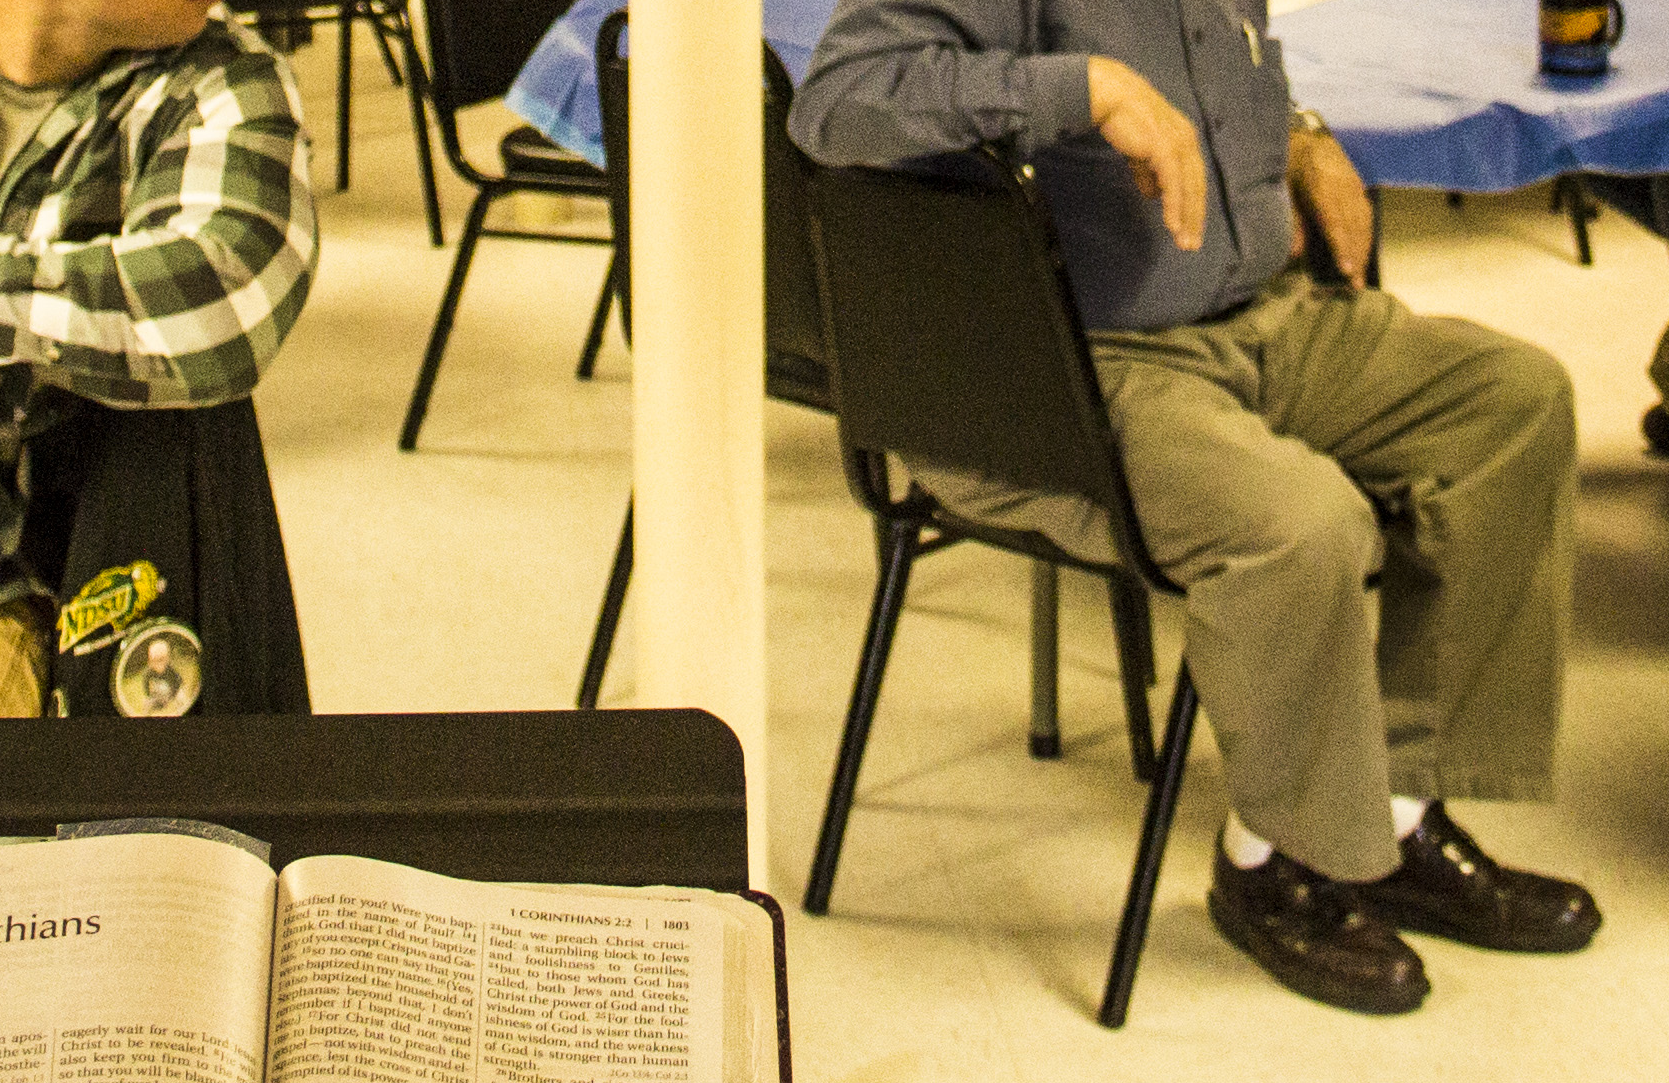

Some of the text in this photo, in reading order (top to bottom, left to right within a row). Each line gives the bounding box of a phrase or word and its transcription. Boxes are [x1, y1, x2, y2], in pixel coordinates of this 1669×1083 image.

[318, 908, 329, 916] in
[337, 909, 356, 917] the
[364, 913, 399, 924] name
[406, 919, 418, 929] of
[423, 924, 454, 938] Paul?
[340, 895, 356, 905] for
[360, 899, 387, 911] you?
[392, 903, 421, 916] Were
[425, 912, 446, 924] you
[450, 915, 477, 930] bap-
[511, 908, 689, 930] 1 CORINTHIANS 2:2 1803
[319, 920, 345, 930] God
[349, 922, 375, 933] that
[377, 926, 382, 934] I
[386, 927, 405, 939] did
[410, 932, 428, 943] not
[432, 936, 476, 955] baptize
[530, 932, 547, 940] we
[555, 932, 597, 945] preach
[606, 937, 644, 948] Christ
[653, 940, 690, 950] cruci-
[301, 934, 475, 968] of you except Crispus and Ga-
[489, 950, 689, 976] and foolishness to Gentiles,
[535, 943, 598, 960] stumbling
[604, 948, 637, 960] block
[644, 952, 655, 961] to
[661, 952, 689, 963] Jews
[306, 960, 359, 973] baptized
[362, 962, 374, 971] in
[377, 966, 395, 976] my
[398, 970, 431, 985] name.
[350, 949, 373, 958] one
[377, 952, 398, 963] can
[403, 958, 421, 971] say
[426, 962, 448, 976] that
[453, 970, 474, 981] you
[488, 976, 689, 1002] called, both Jews and Greeks,
[527, 968, 539, 977] to
[547, 969, 580, 981] those
[588, 973, 625, 984] whom
[634, 975, 660, 986] God
[667, 977, 689, 988] has
[487, 988, 689, 1014] Christ the power of God and the
[487, 1003, 535, 1018] wisdom
[541, 1008, 553, 1019] of
[559, 1010, 588, 1022] God.
[635, 1014, 654, 1024] the
[661, 1016, 689, 1027] fool-
[12, 1032, 47, 1044] apos-
[62, 1024, 229, 1048] eagerly wait for our Lord
[486, 1016, 689, 1040] ishness of God is wiser than hu-
[22, 1044, 47, 1055] will
[61, 1038, 208, 1056] Christ to be revealed.
[485, 1030, 689, 1052] man wisdom, and the weakness
[60, 1055, 86, 1065] also
[93, 1052, 125, 1064] keep
[132, 1053, 155, 1066] you
[162, 1053, 189, 1065] firm
[197, 1060, 208, 1070] to
[484, 1056, 540, 1072] strength.
[485, 1041, 689, 1066] of God is stronger than human
[59, 1065, 180, 1080] so that you will be
